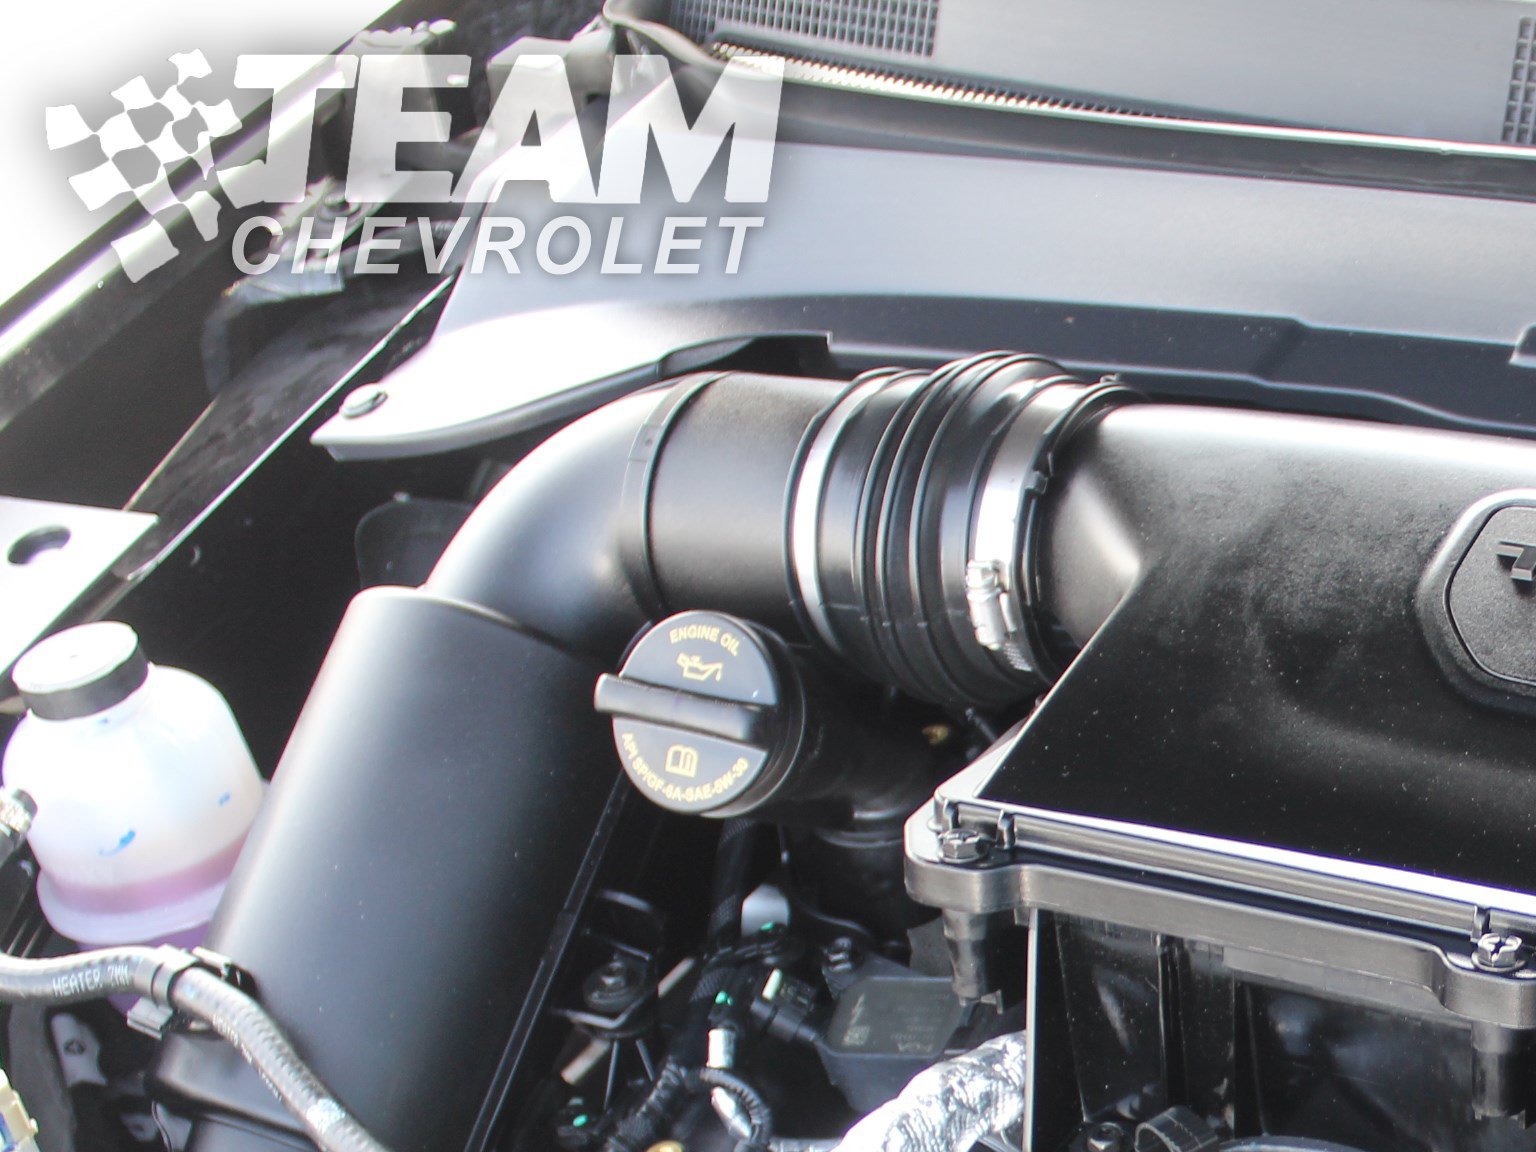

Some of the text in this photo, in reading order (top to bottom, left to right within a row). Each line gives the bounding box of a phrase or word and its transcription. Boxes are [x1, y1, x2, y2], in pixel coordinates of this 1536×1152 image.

[669, 625, 741, 656] ENGINE OIL
[52, 969, 101, 996] HEATER
